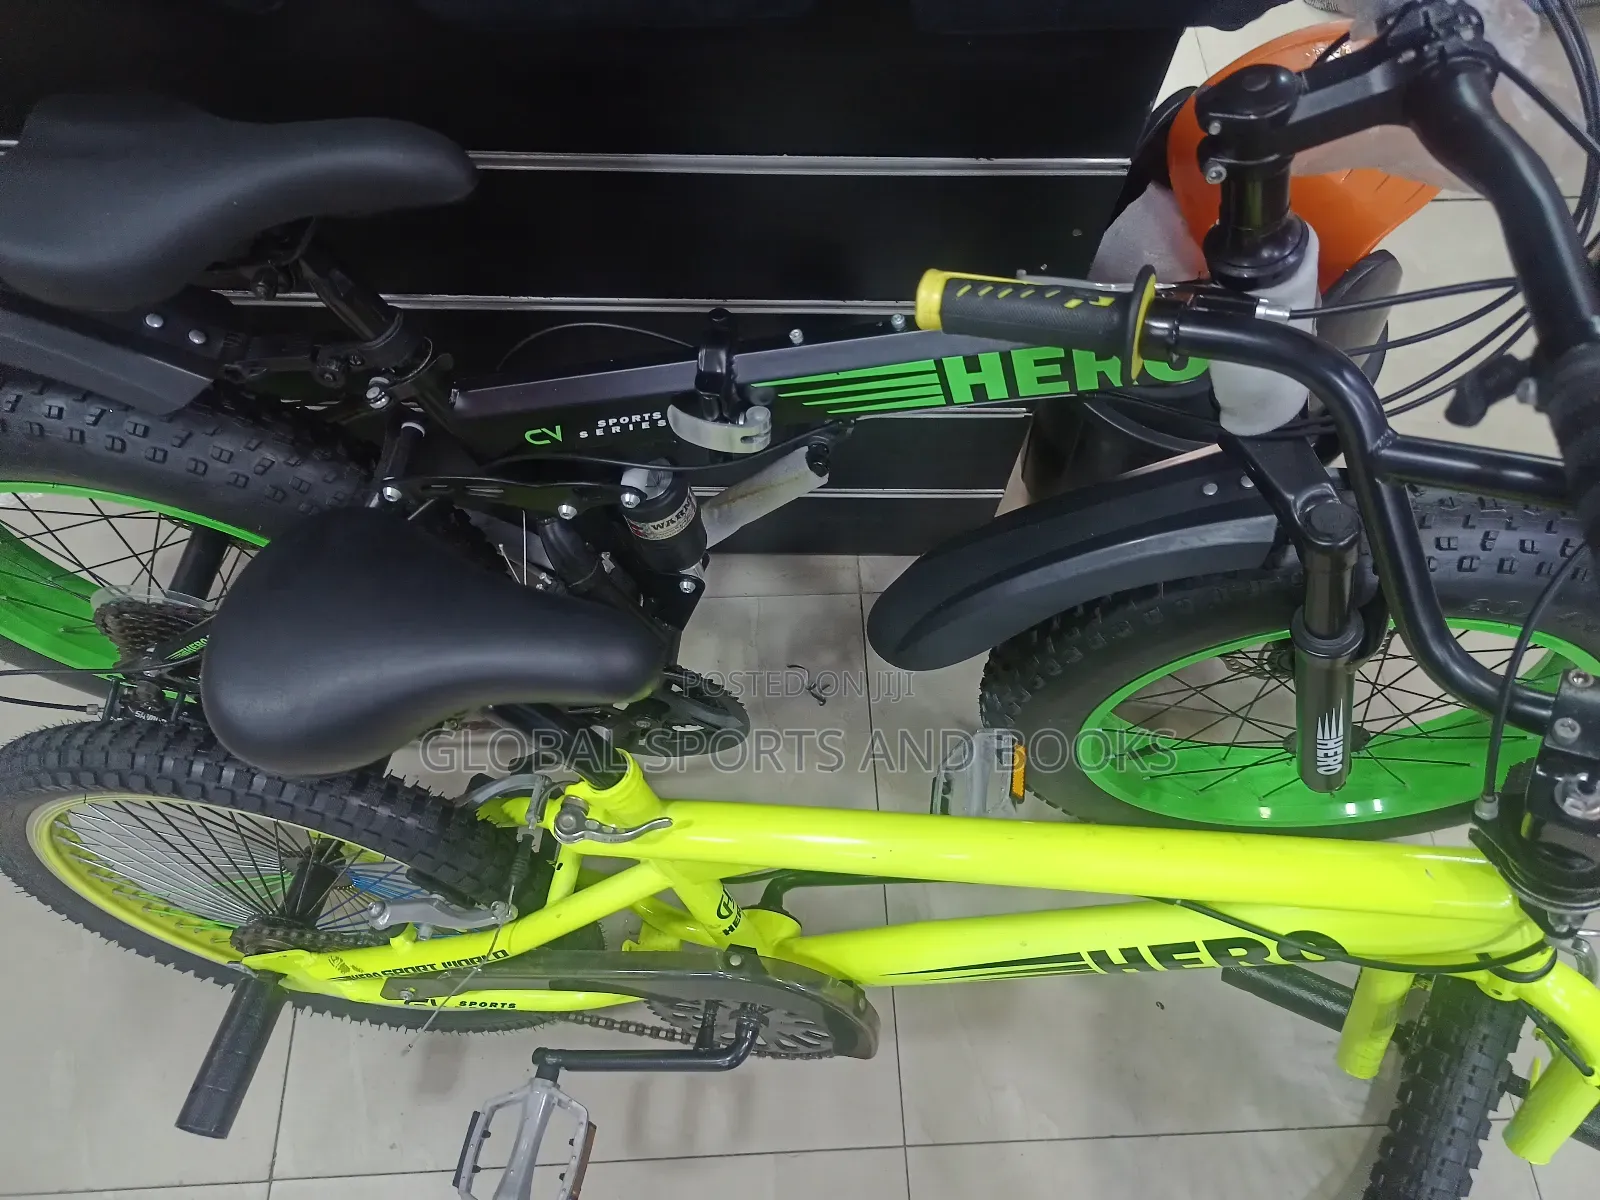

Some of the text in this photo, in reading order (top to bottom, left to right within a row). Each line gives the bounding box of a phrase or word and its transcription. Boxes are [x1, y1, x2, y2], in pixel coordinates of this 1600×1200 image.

[597, 411, 662, 428] SPORTS
[579, 419, 667, 439] SERIES
[1316, 735, 1344, 776] HERO
[1086, 930, 1350, 974] HERO
[381, 963, 437, 977] SPORT
[458, 1000, 517, 1009] SPORTS
